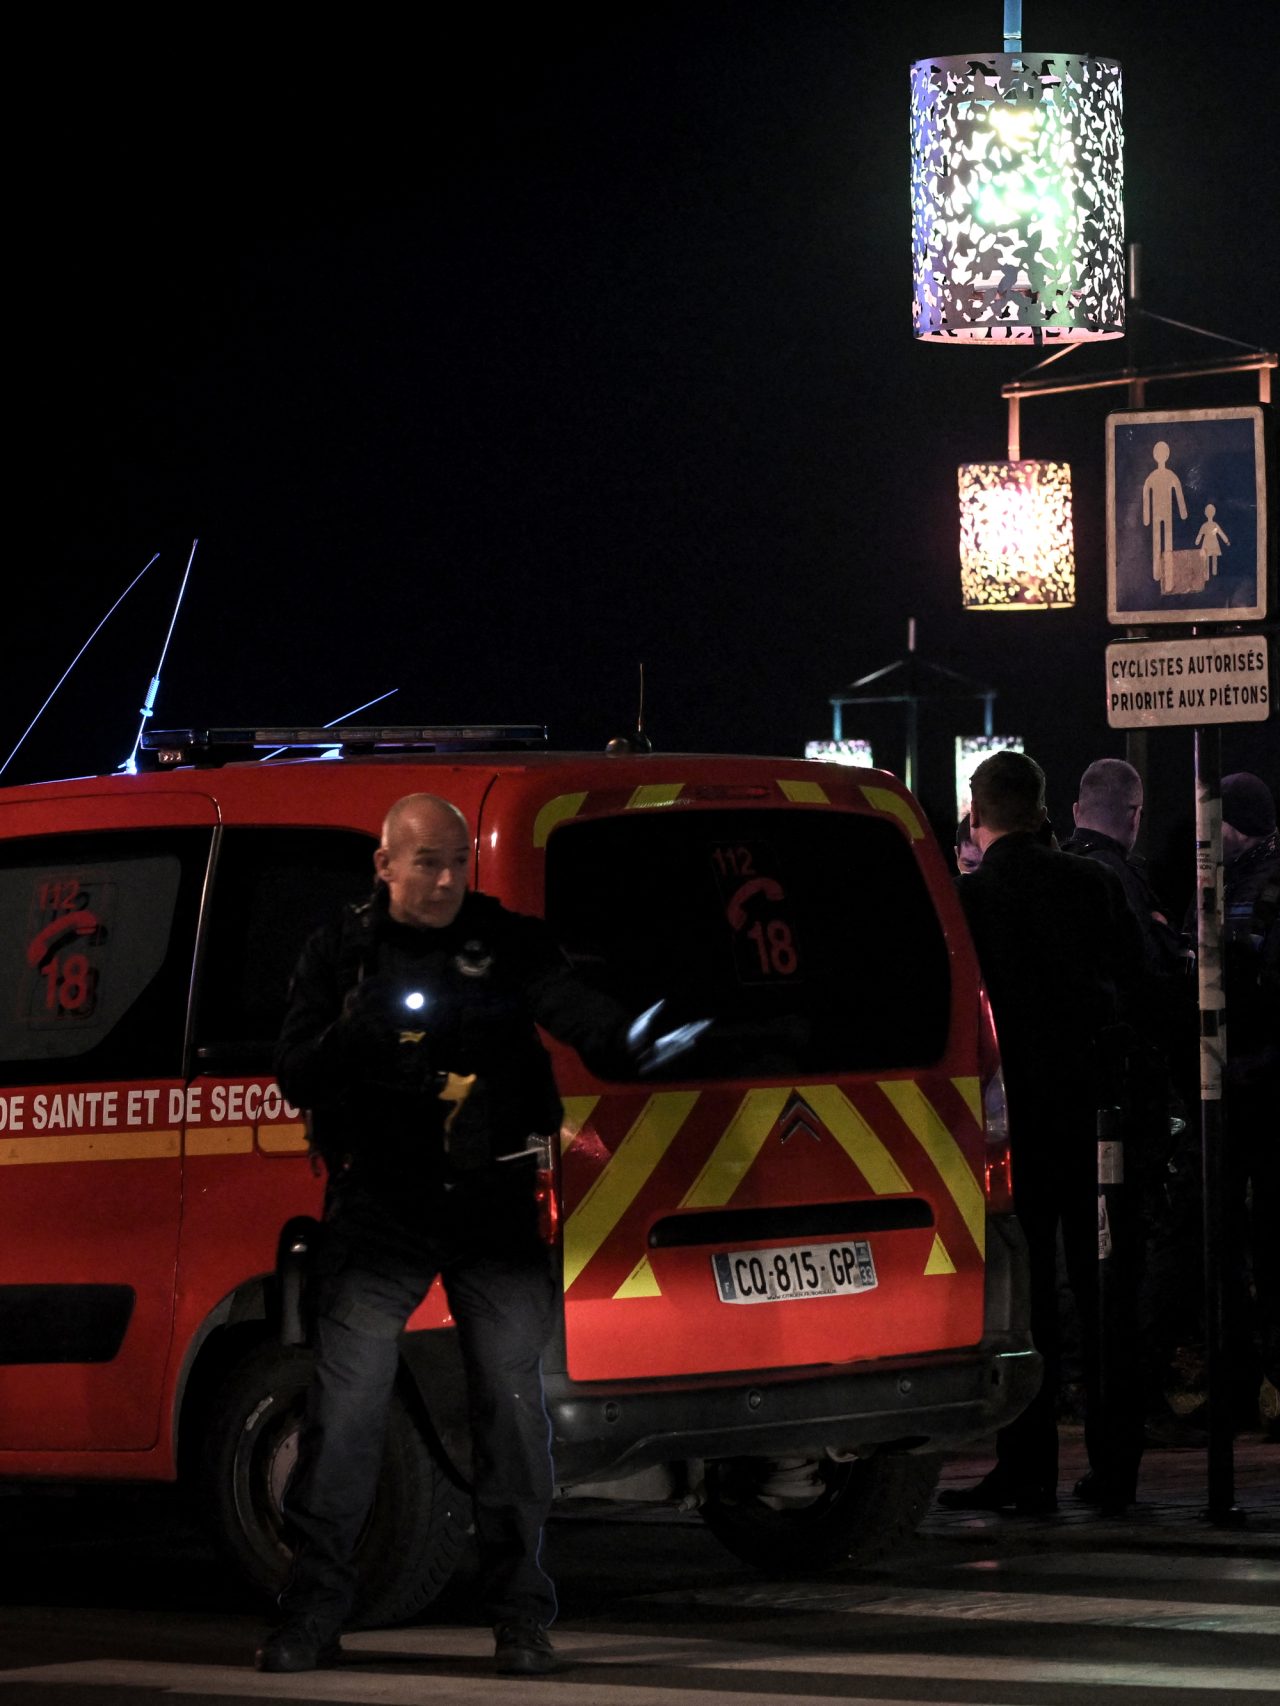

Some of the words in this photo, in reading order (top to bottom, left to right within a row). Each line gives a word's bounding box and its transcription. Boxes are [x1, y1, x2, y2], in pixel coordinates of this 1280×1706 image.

[1111, 657, 1183, 678] CYCLISTES
[1188, 650, 1264, 675] AUTORISÉS
[1111, 688, 1174, 711] PRIORITÉ
[1179, 689, 1205, 708] AUX
[1210, 684, 1268, 706] PIÉTONS
[711, 847, 757, 876] 112
[38, 879, 80, 912] 112
[747, 919, 798, 975] 18
[40, 953, 89, 1009] 18
[32, 1091, 118, 1130] SANTE
[126, 1089, 160, 1126] ET
[168, 1087, 202, 1123] DE
[860, 1266, 875, 1283] 33
